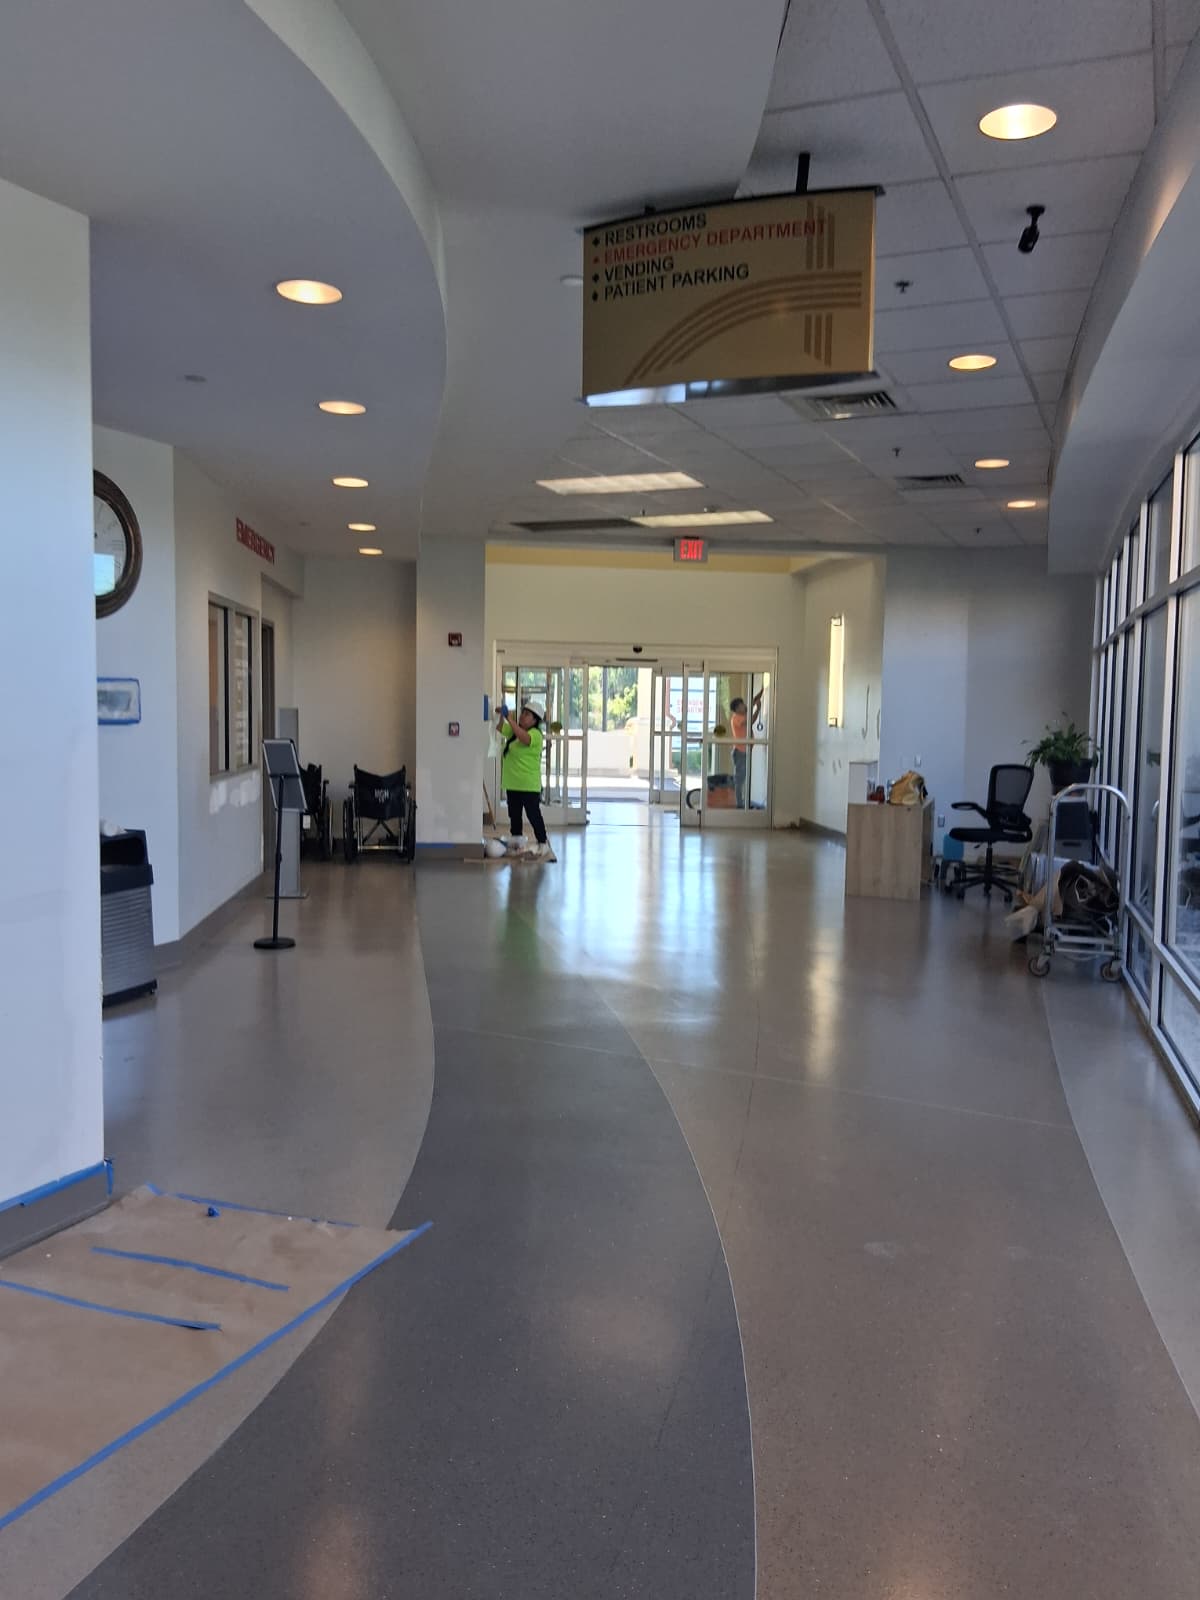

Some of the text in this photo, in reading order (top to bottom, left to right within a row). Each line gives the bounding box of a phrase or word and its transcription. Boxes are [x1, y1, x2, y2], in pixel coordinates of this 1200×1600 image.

[604, 213, 707, 247] RESTROOMS
[604, 218, 826, 264] EMERGENCY DEPARTMENT
[604, 256, 674, 282] VENDING
[604, 263, 750, 301] PATIENT PARKING
[236, 517, 275, 566] EMERGENCY
[680, 540, 704, 560] EXIT
